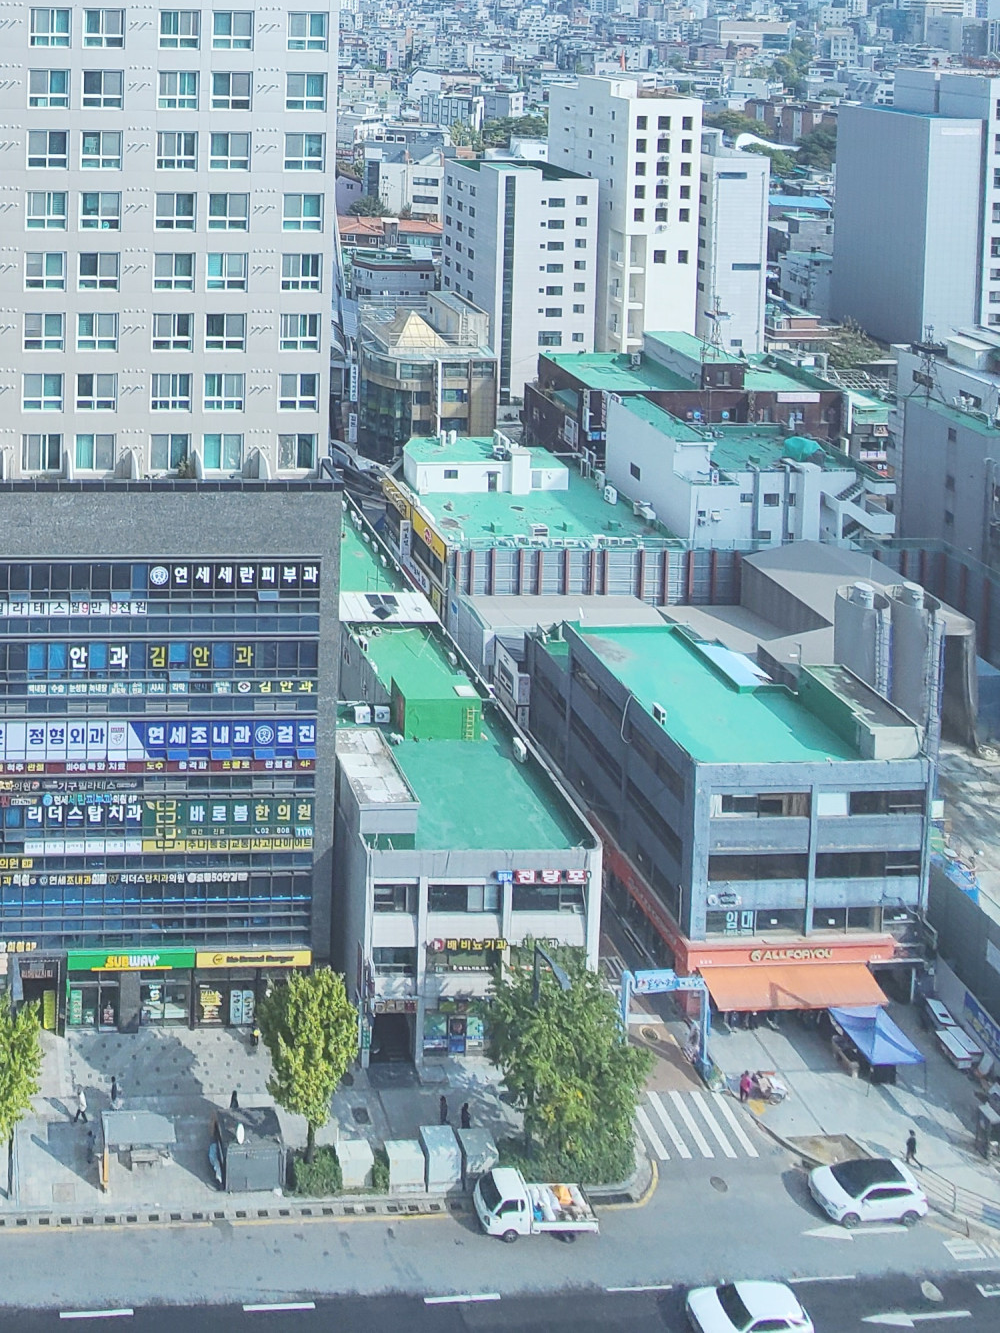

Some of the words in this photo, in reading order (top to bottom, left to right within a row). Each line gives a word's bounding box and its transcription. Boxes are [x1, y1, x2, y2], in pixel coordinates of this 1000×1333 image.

[174, 566, 318, 584] 연세세란피부과
[70, 645, 128, 668] 안과
[150, 645, 253, 668] 김안과
[258, 681, 313, 693] 김안과
[29, 727, 105, 745] 정형외과
[148, 725, 251, 744] 연세조내과
[277, 725, 316, 743] 검진
[27, 804, 143, 823] 리더스탑치과
[517, 870, 585, 884] 전당포
[726, 910, 753, 929] 임대
[446, 939, 508, 951] 배비뇨기과
[104, 954, 159, 968] SUBWAY
